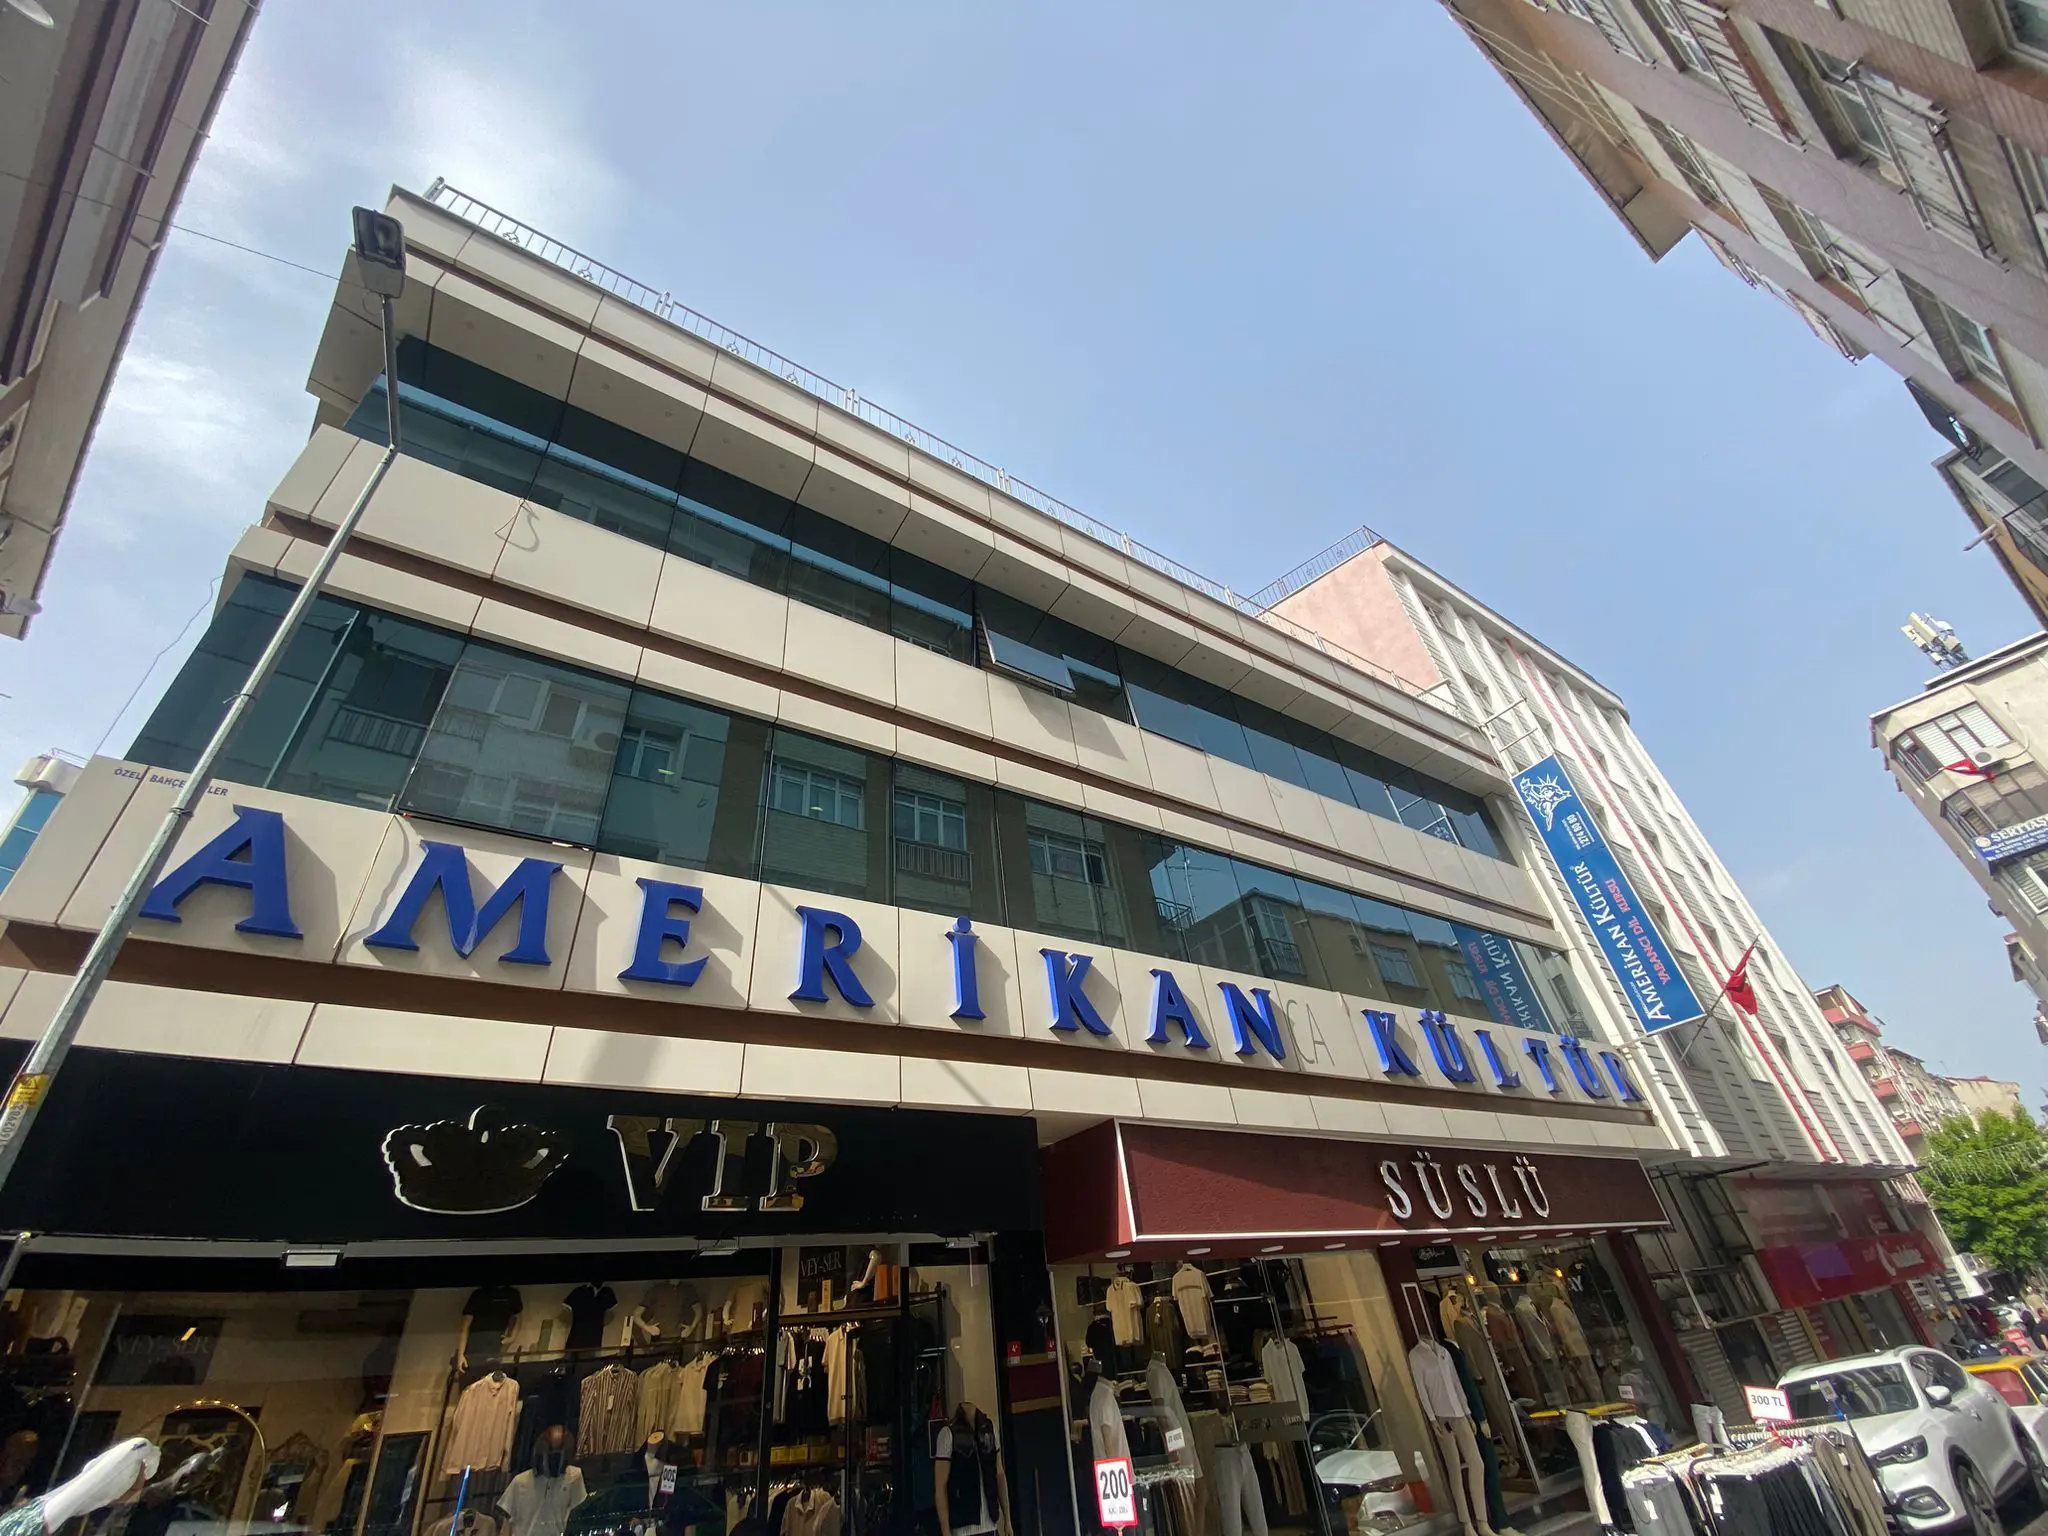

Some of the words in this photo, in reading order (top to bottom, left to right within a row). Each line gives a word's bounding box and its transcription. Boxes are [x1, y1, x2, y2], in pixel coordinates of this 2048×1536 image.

[114, 767, 142, 780] ÖZEL
[149, 774, 229, 797] BAHÇELER
[1574, 861, 1615, 926] KÜLTÜR
[1604, 878, 1632, 913] KURSU
[1626, 915, 1645, 936] DİL
[139, 810, 1287, 1062] AMERİKAN
[1360, 1007, 1646, 1101] KÜLTÜR
[1607, 924, 1672, 1021] AMERİKAN
[1638, 935, 1670, 985] YABANCI
[606, 1114, 839, 1212] VIP
[1379, 1150, 1550, 1219] SÜSLÜ
[1751, 1394, 1770, 1406] 300
[1771, 1396, 1785, 1407] TL
[1100, 1468, 1129, 1500] 200
